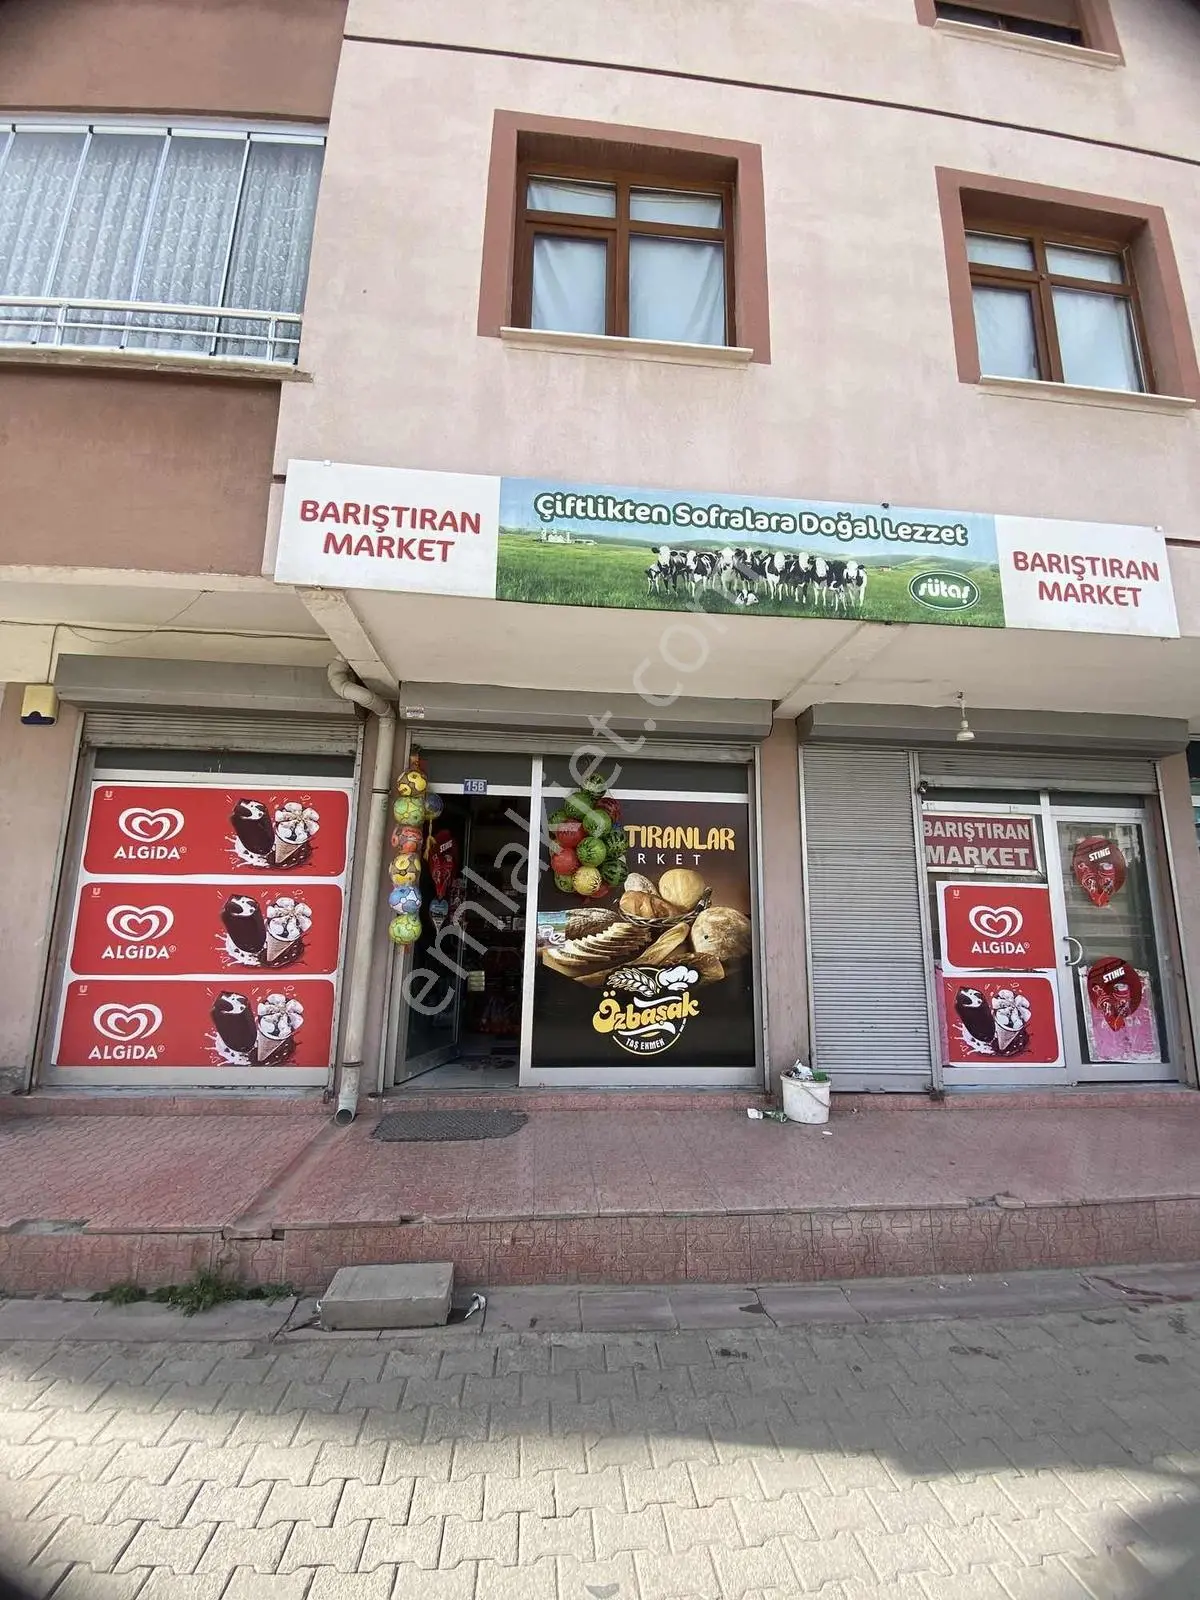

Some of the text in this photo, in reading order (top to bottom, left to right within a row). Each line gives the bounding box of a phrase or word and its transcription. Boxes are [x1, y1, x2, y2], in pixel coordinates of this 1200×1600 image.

[300, 500, 481, 535] BARIŞTIRAN
[535, 493, 968, 546] Çiftlikten Sofralara Doğal Lezzet
[323, 532, 455, 563] MARKET
[1013, 551, 1160, 582] BARIŞTIRAN
[917, 577, 972, 606] sütaş
[1038, 581, 1142, 607] MARKET
[466, 781, 485, 792] 15B
[923, 820, 1030, 842] BARIŞTIRAN
[925, 845, 1030, 867] MARKET
[1088, 847, 1110, 861] STING
[1102, 966, 1126, 983] STING
[592, 990, 700, 1033] Özbaşak
[625, 1037, 640, 1051] TAŞ
